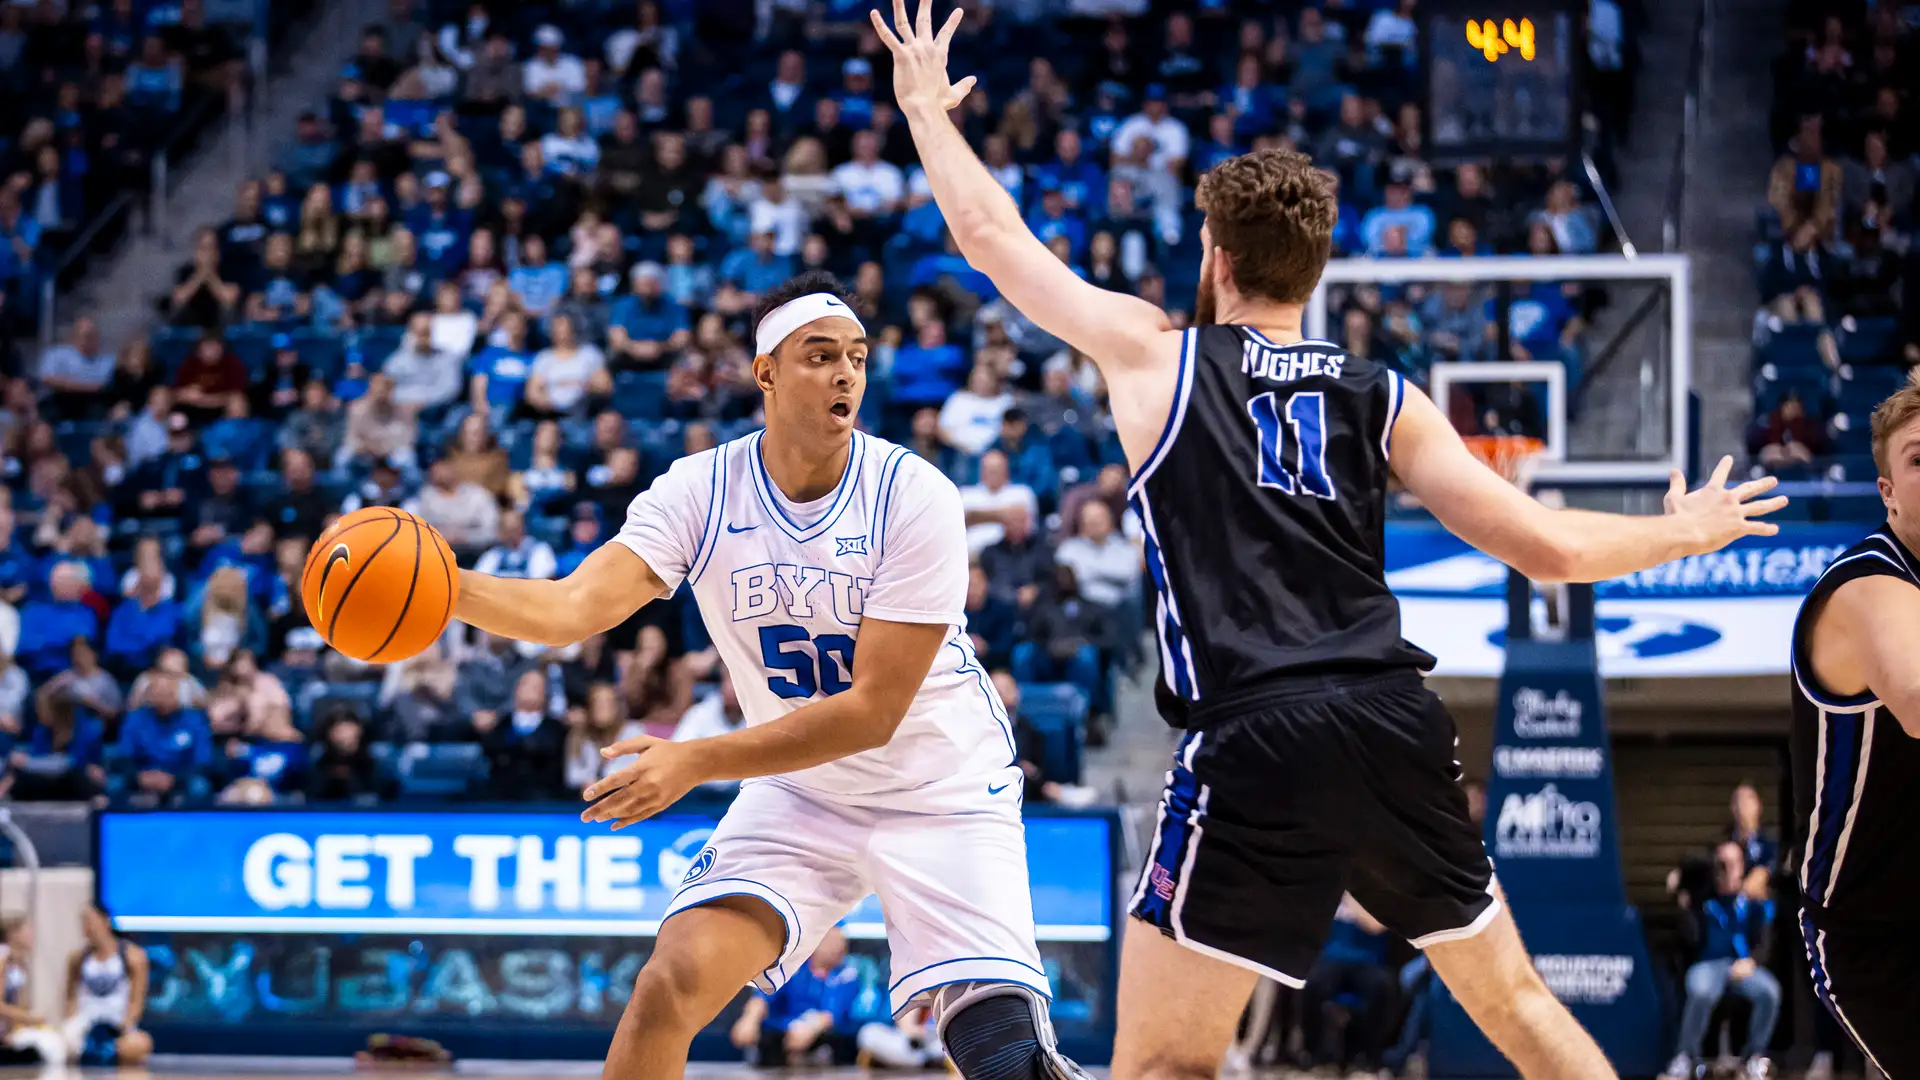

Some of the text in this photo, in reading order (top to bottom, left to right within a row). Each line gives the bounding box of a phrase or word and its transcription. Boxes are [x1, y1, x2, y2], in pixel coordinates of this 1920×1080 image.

[1466, 17, 1535, 63] 4.4
[1247, 391, 1336, 501] 11
[731, 563, 873, 626] BYU
[758, 624, 856, 700] 50
[243, 832, 643, 913] GET THE
